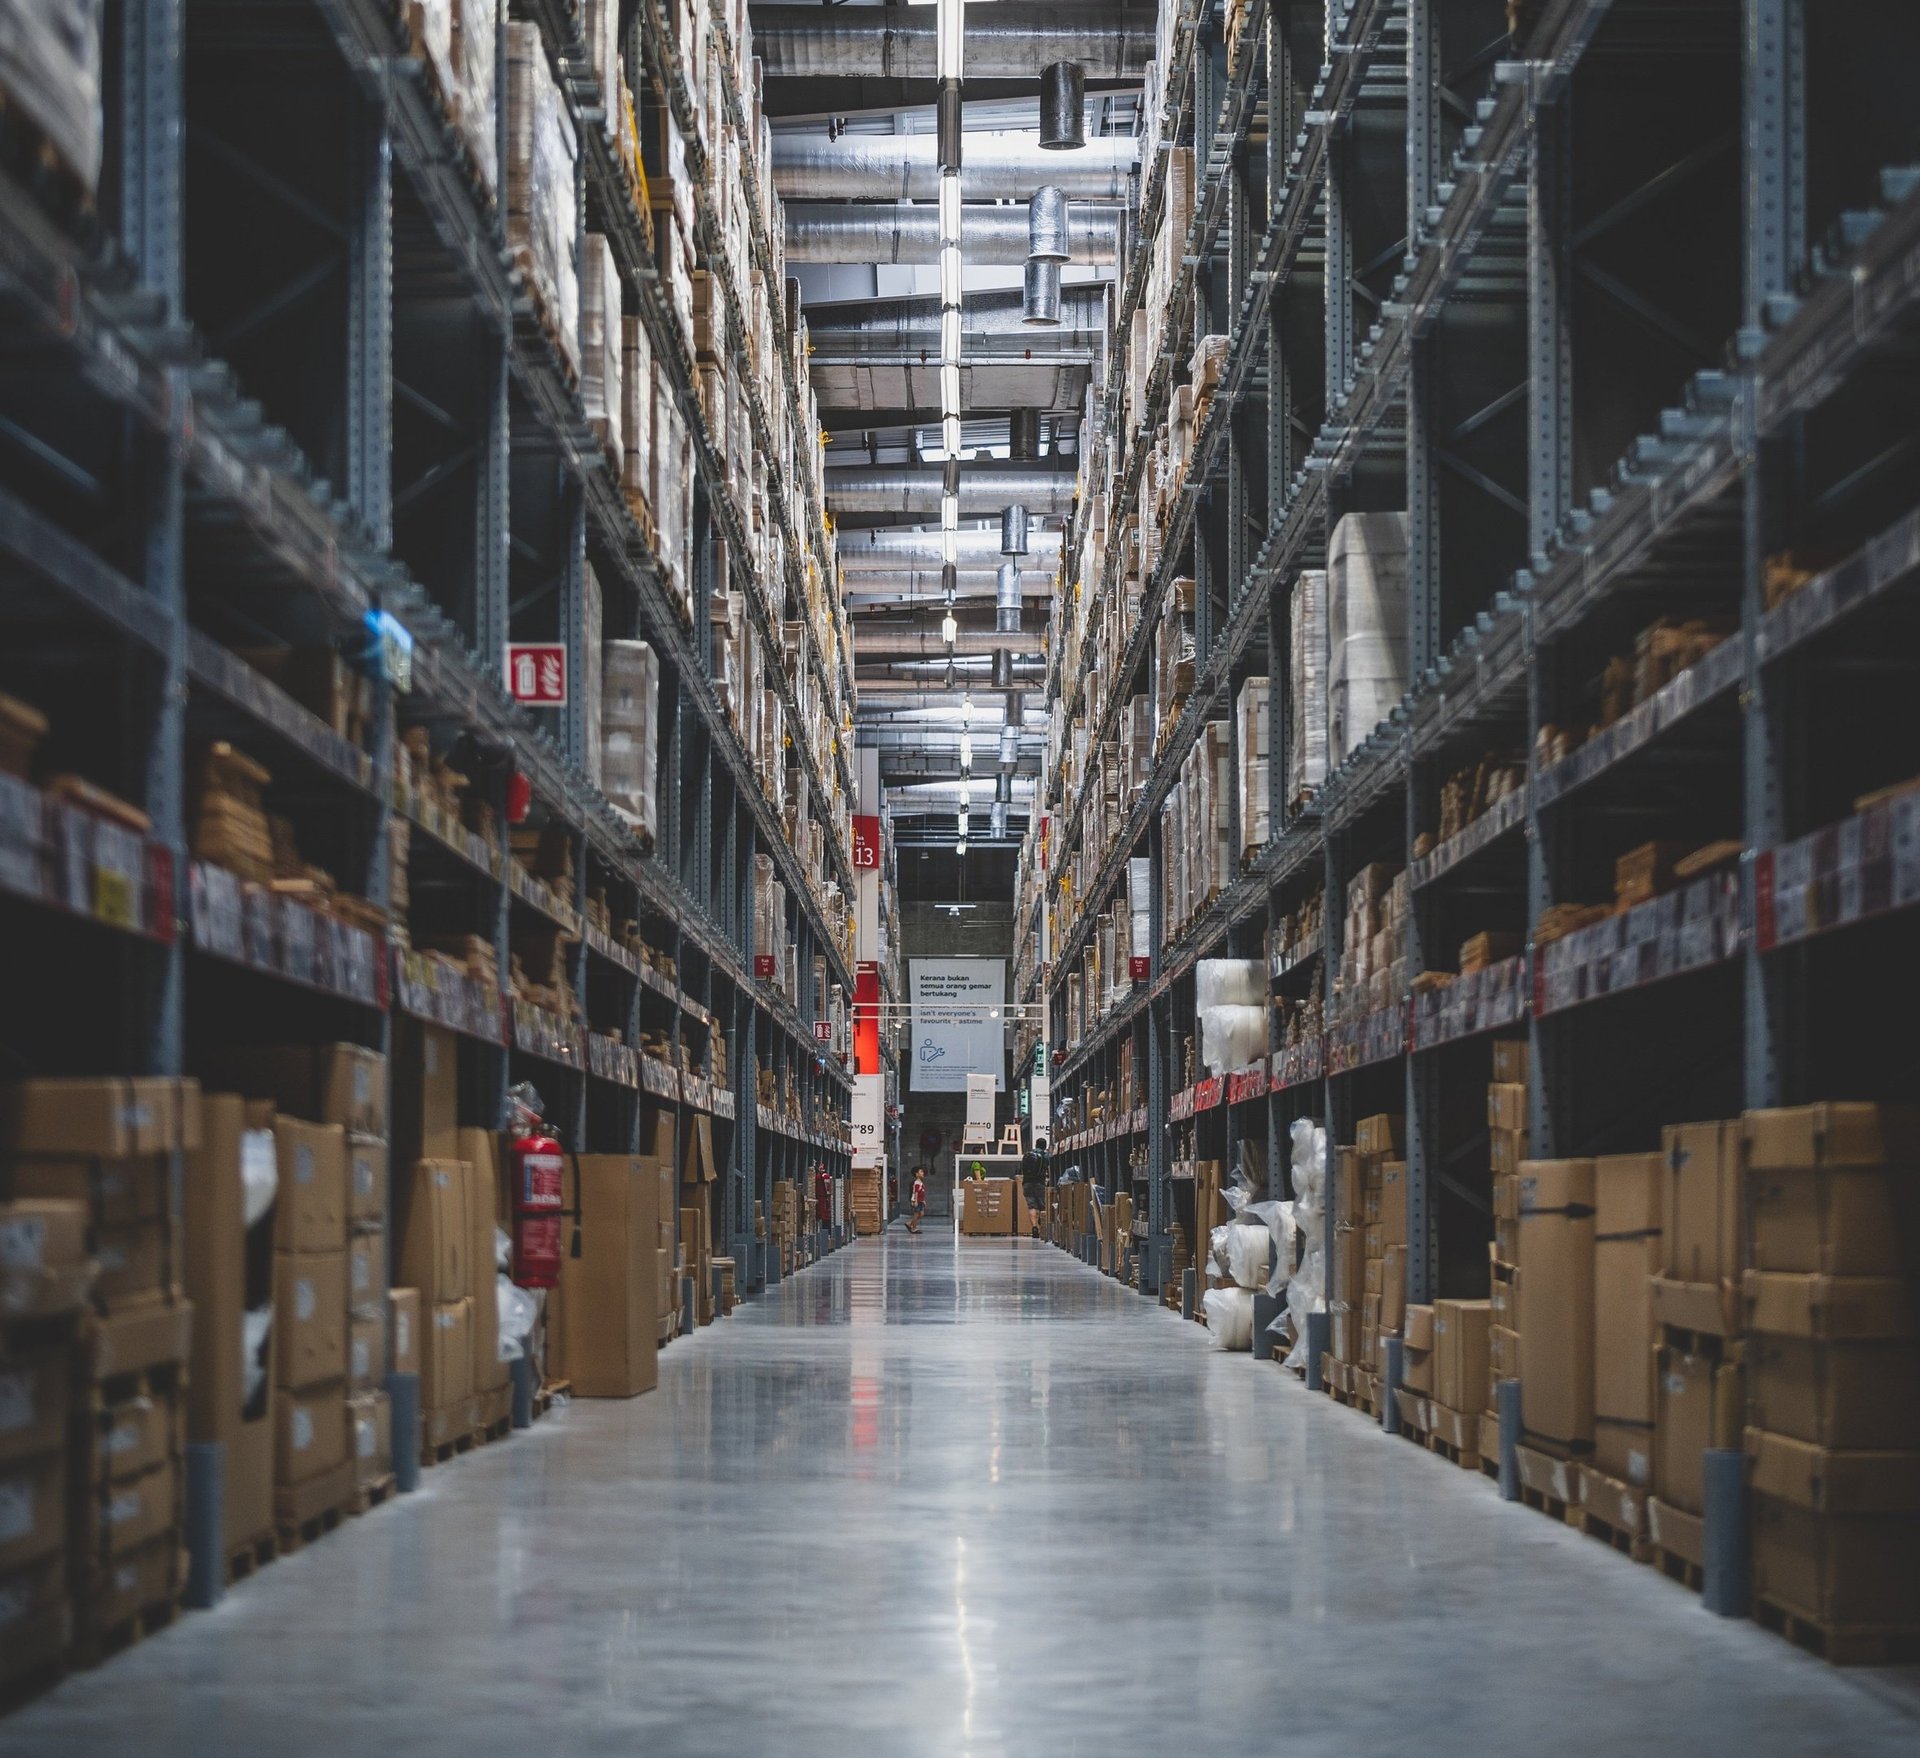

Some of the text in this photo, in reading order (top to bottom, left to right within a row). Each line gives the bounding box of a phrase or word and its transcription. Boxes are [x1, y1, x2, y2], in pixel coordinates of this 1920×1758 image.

[855, 847, 873, 866] 13
[937, 1009, 976, 1017] everyone's
[860, 1124, 875, 1134] 89
